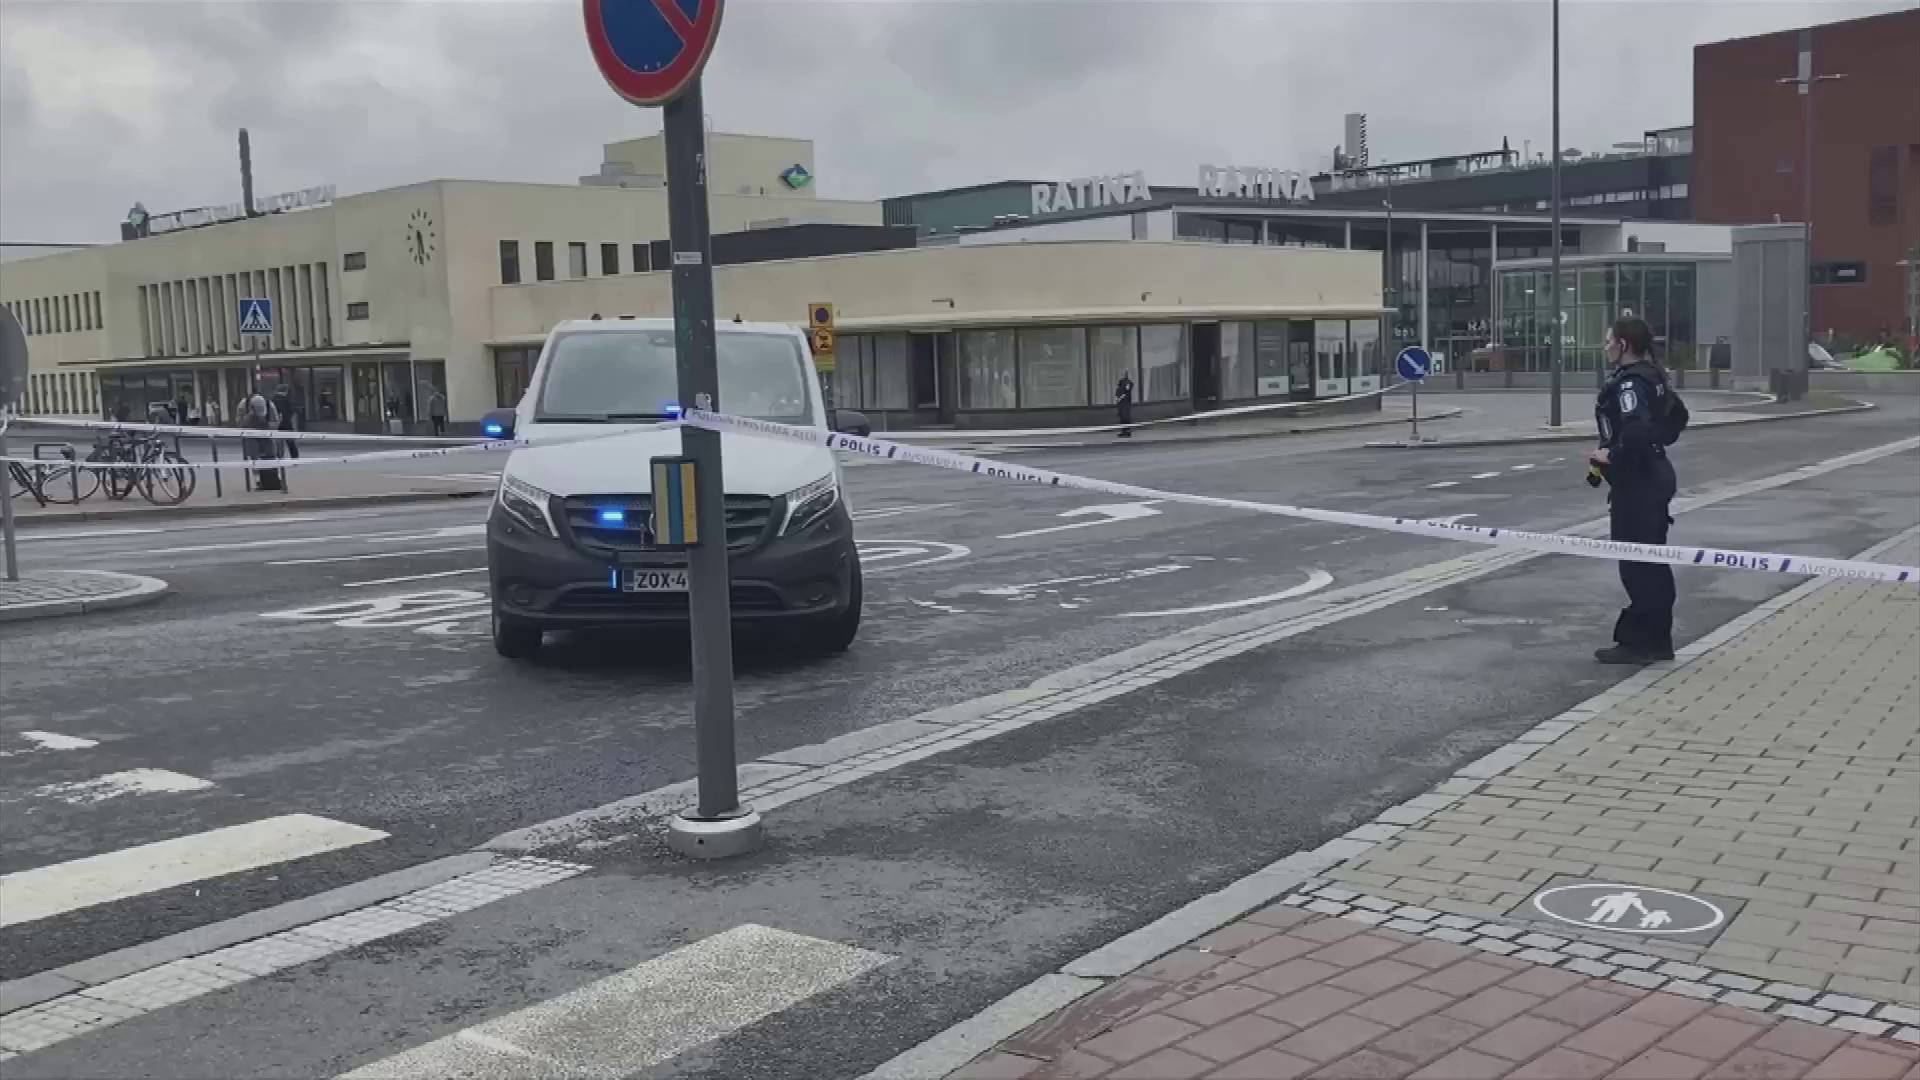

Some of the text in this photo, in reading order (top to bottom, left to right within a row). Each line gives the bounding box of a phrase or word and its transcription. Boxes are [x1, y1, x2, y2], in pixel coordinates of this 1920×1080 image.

[1031, 170, 1152, 215] RATINA
[1198, 164, 1315, 200] RATINA
[839, 438, 881, 455] POLIS
[1714, 553, 1769, 571] POLIS
